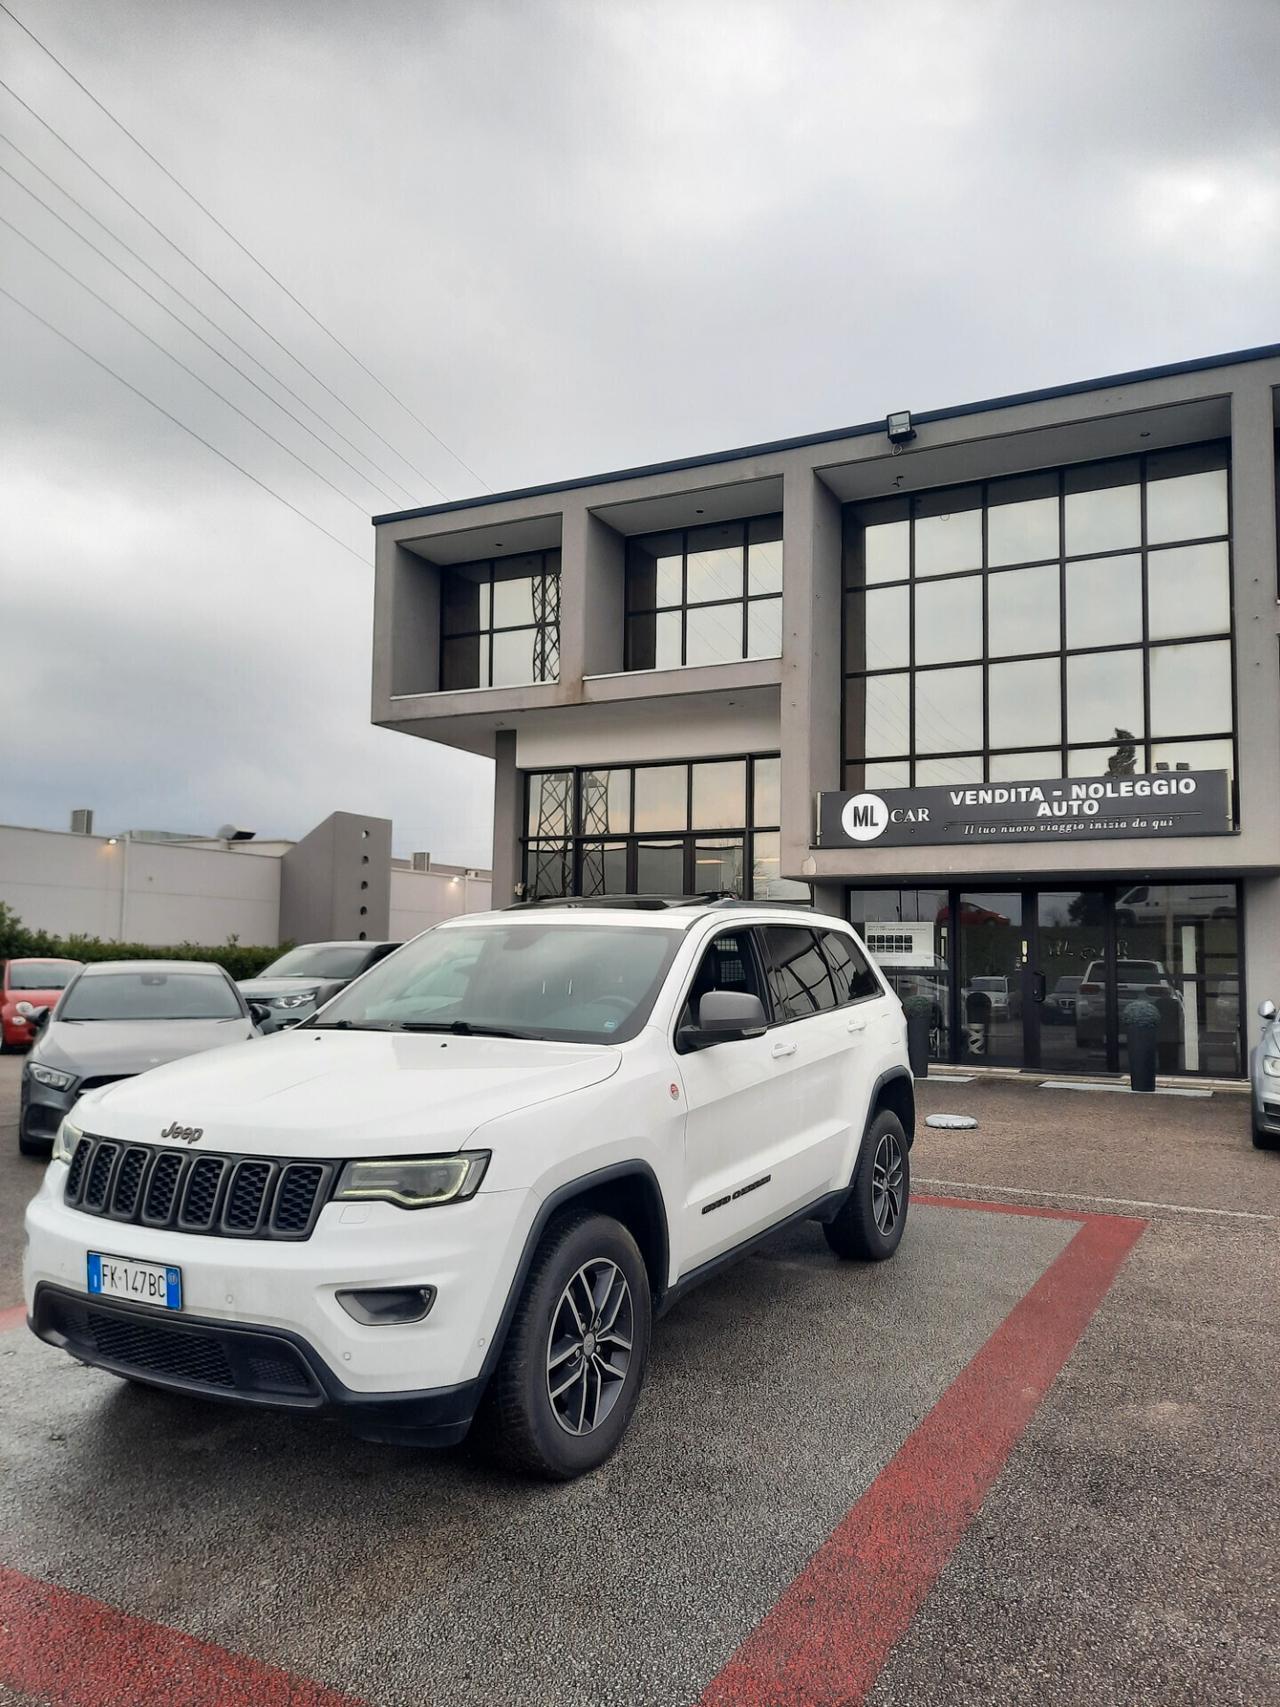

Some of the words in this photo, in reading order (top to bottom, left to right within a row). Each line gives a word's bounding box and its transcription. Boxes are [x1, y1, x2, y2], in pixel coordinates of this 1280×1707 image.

[949, 786, 1045, 806] VENDITA
[1071, 777, 1197, 800] NOLEGGIO
[853, 805, 879, 828] ML
[890, 807, 931, 823] CAR
[1036, 799, 1100, 817] AUTO
[964, 825, 975, 835] Il
[978, 826, 997, 834] tuo
[1000, 825, 1036, 834] nuovo
[1040, 821, 1085, 834] viaggio
[1089, 819, 1127, 830] inizia
[1132, 817, 1148, 828] da
[1152, 816, 1174, 830] qui
[160, 1121, 204, 1145] Jeep
